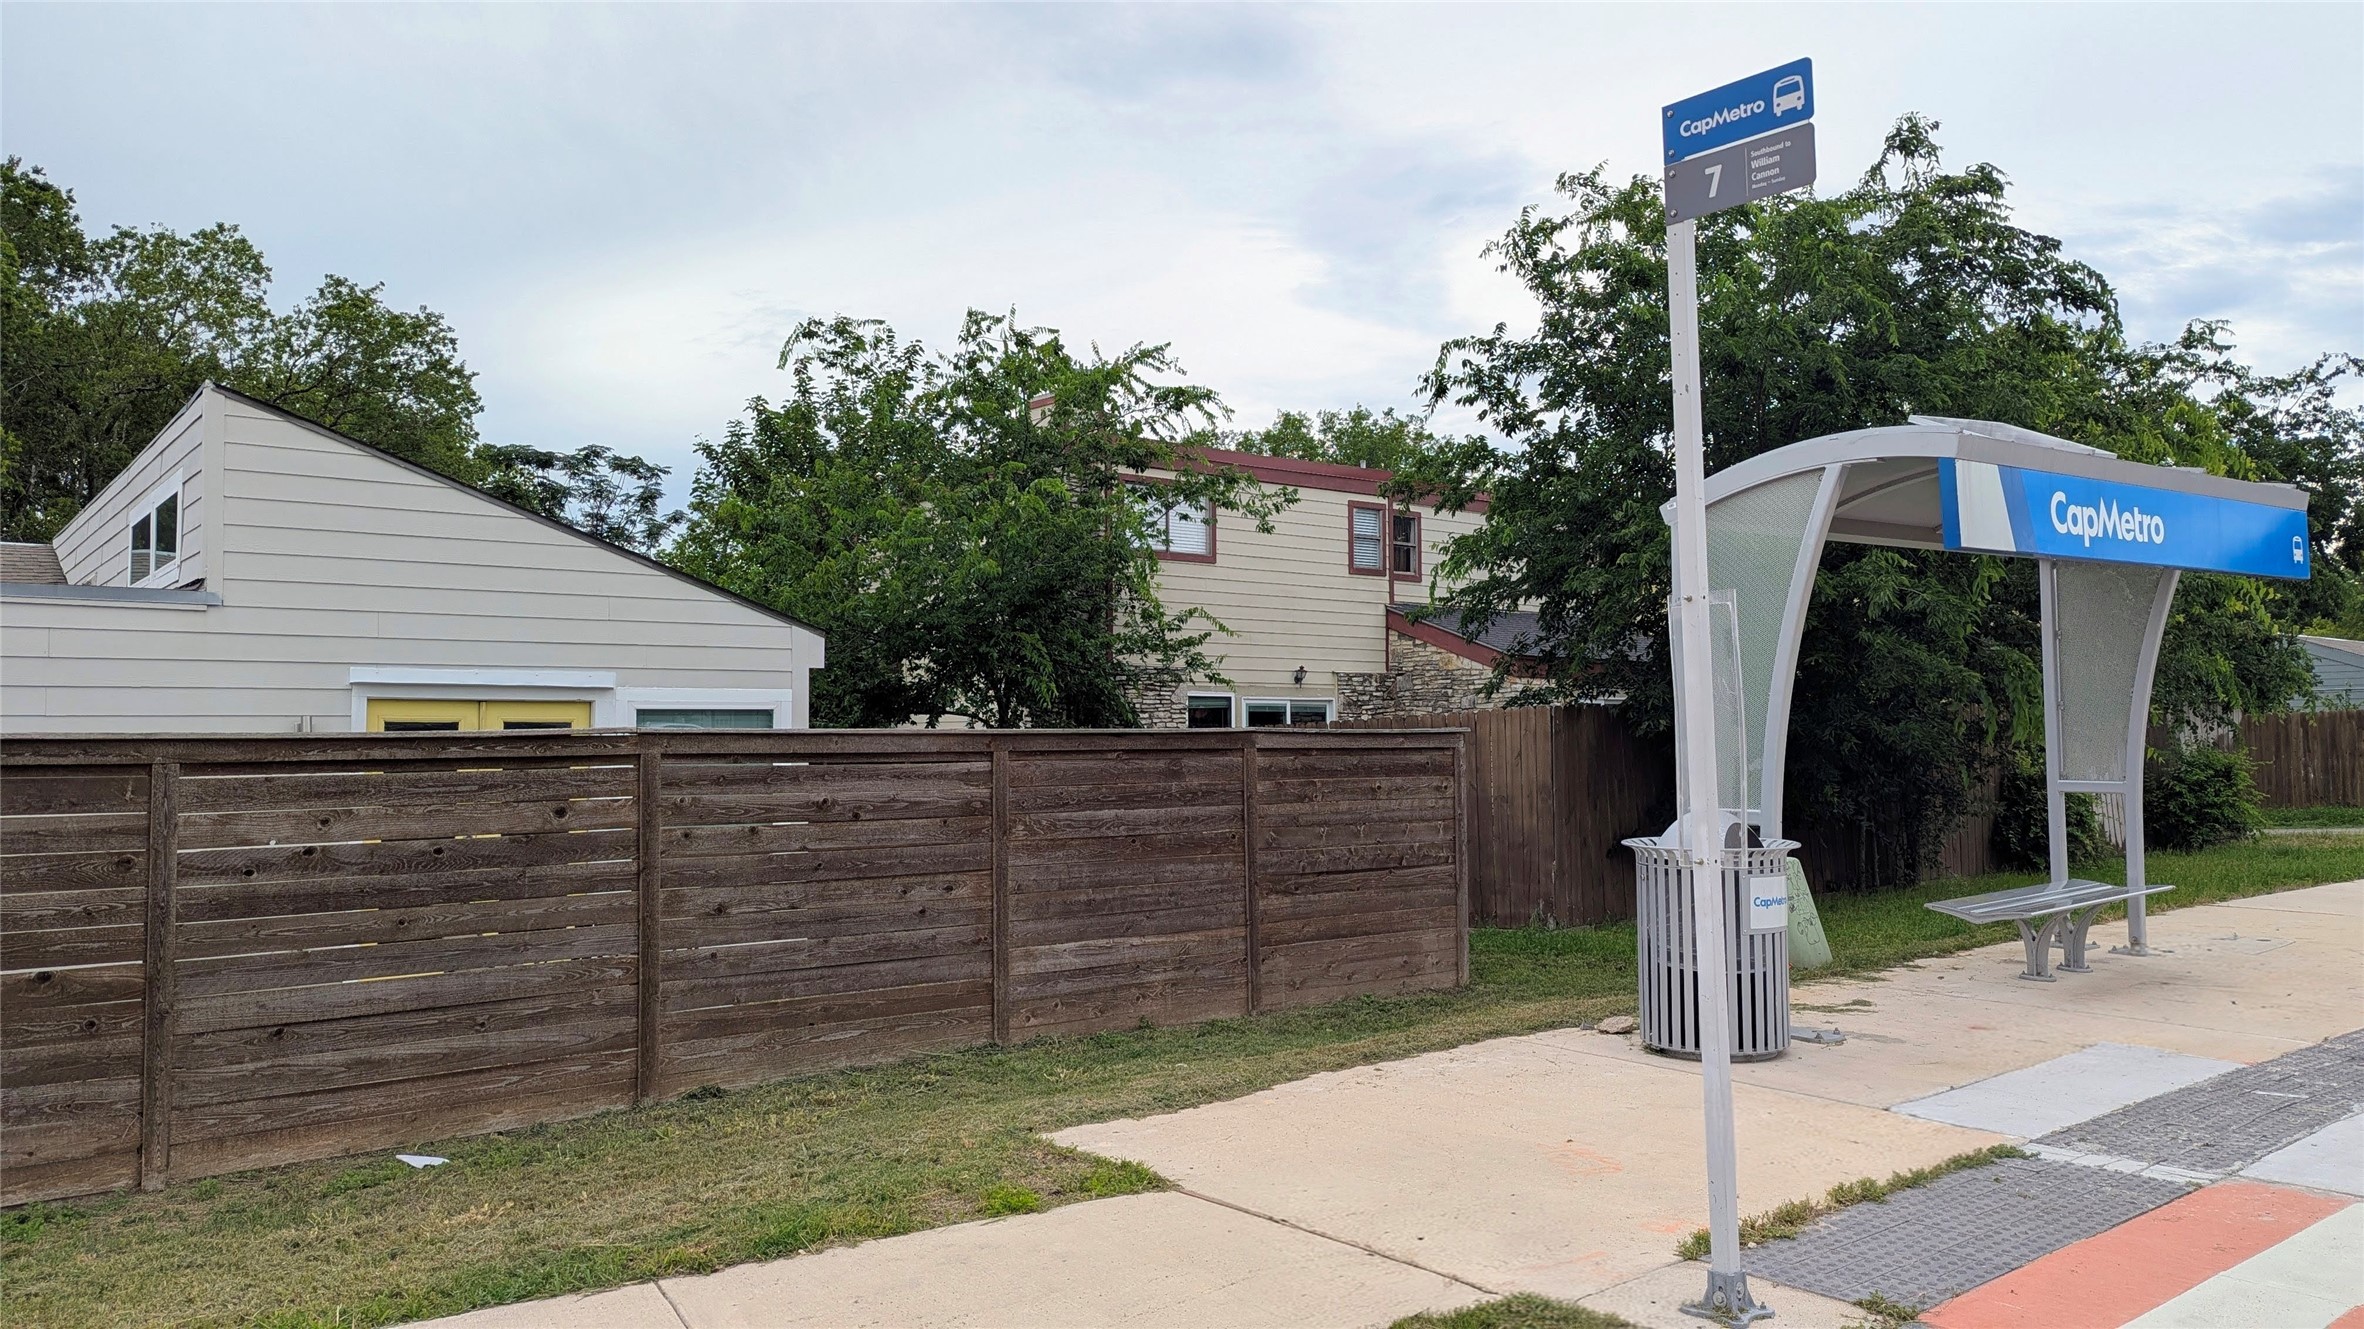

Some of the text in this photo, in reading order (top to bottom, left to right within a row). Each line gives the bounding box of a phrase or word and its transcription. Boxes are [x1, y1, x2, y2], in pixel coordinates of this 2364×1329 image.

[1679, 100, 1765, 137] CapMetro
[1750, 141, 1784, 158] Southbound
[1750, 155, 1780, 169] William
[1704, 164, 1722, 198] 7
[1751, 167, 1780, 181] Cannon
[2050, 491, 2165, 547] CapMetro
